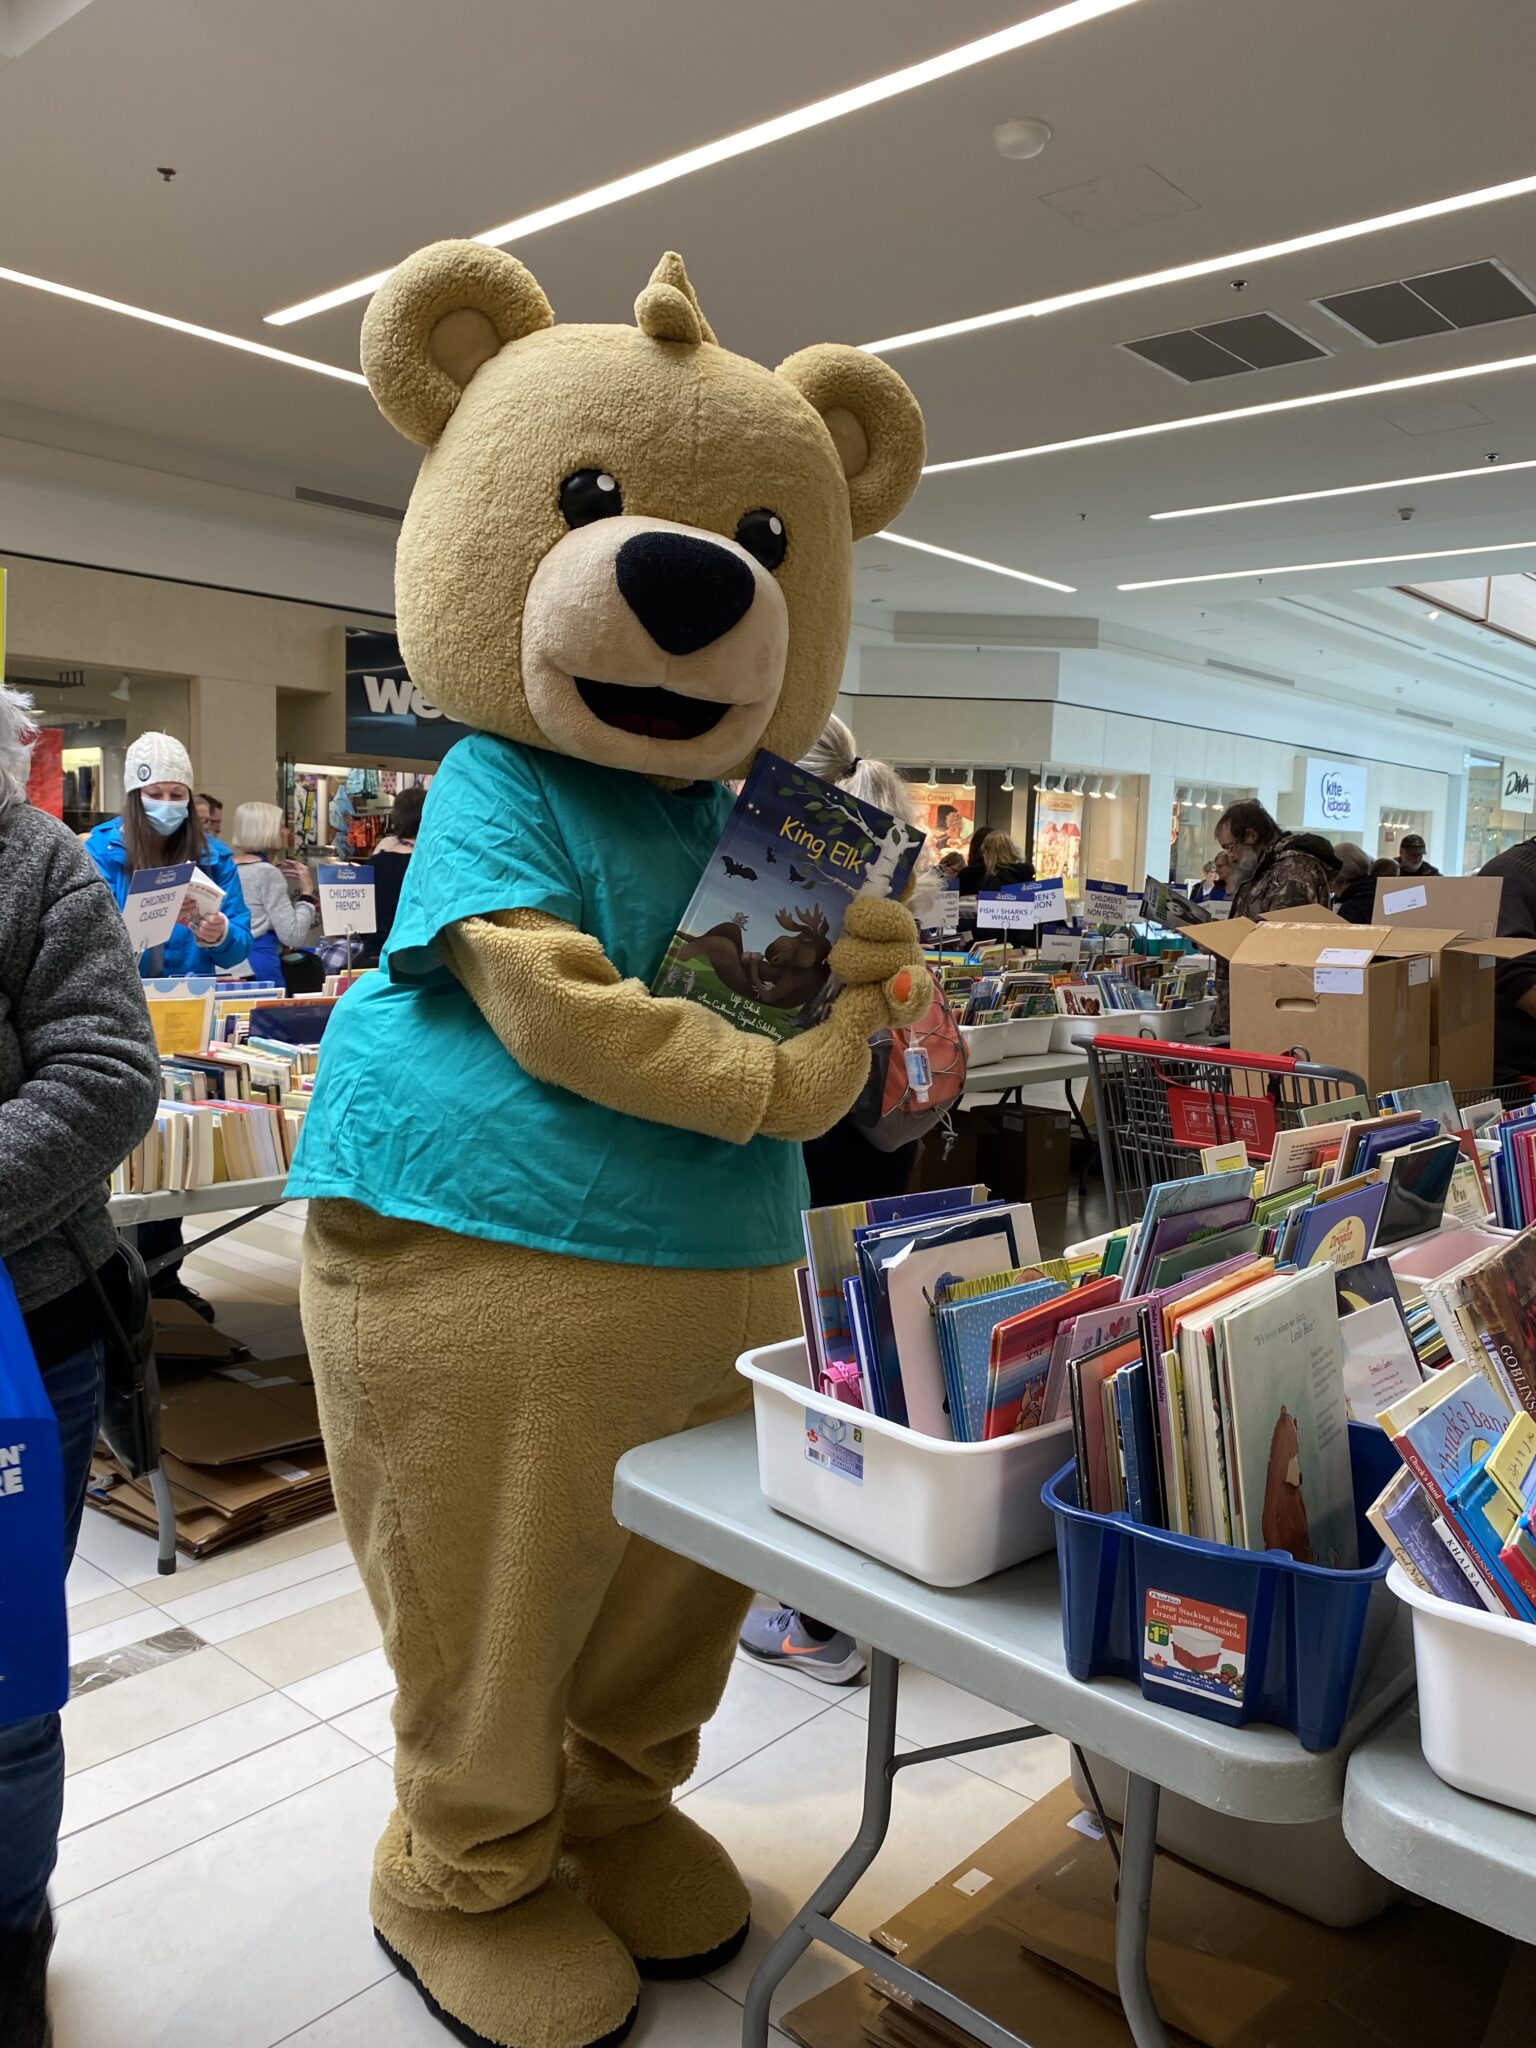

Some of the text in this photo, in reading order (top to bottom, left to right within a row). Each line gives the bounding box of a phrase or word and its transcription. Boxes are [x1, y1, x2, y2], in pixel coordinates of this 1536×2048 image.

[363, 675, 461, 723] We
[780, 815, 864, 875] King Elk
[329, 888, 366, 899] CHILDREN'S
[335, 900, 361, 911] FRENCH
[1090, 893, 1123, 906] CHILDREN'S
[139, 906, 169, 922] CLASSICS
[991, 914, 1020, 922] WHALES
[1087, 908, 1124, 921] NON FICTION
[1409, 1455, 1442, 1500] Chuck's Band
[1447, 1539, 1480, 1587] KHALSA
[1466, 1540, 1495, 1581] ANDERSON
[1152, 1608, 1177, 1621] Grand
[1178, 1617, 1203, 1629] panier
[1203, 1624, 1242, 1639] empilable
[1156, 1600, 1178, 1613] Large
[1179, 1606, 1211, 1622] Stacking
[1213, 1615, 1239, 1630] Basket
